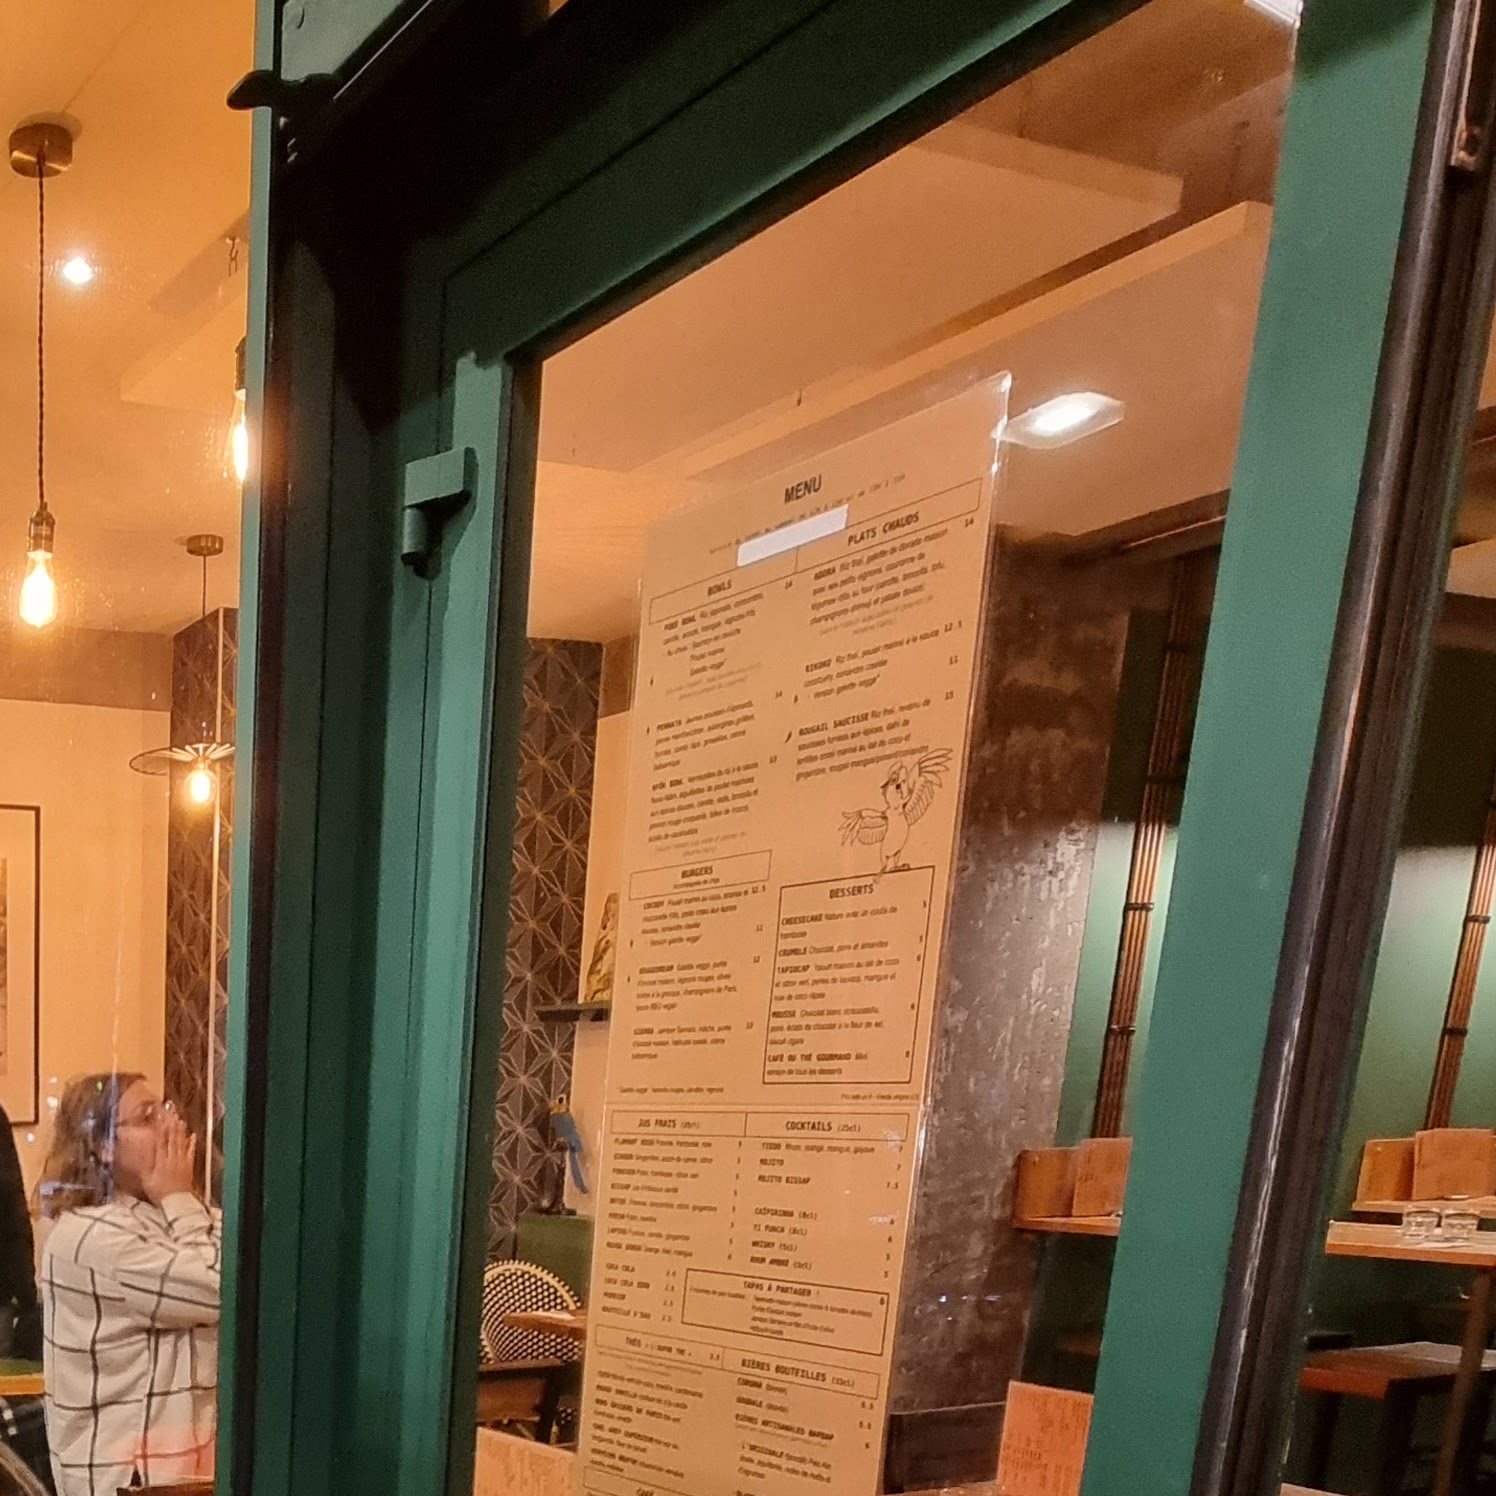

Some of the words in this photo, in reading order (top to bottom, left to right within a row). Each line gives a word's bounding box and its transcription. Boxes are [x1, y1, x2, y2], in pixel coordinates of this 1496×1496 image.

[783, 472, 823, 505] MENU
[847, 526, 876, 547] PLATS
[882, 510, 920, 534] CHAUDS
[964, 516, 974, 527] 14
[707, 578, 731, 596] BOWLS
[798, 721, 828, 736] ROUGAIL
[833, 711, 869, 728] SAUCISSE
[680, 864, 713, 878] BURGERS
[828, 883, 874, 899] DESSERTS
[781, 913, 822, 925] CHEESECAKE
[767, 1053, 784, 1062] CAFÉ
[787, 1053, 796, 1061] OU
[637, 1118, 651, 1127] JUS
[654, 1119, 676, 1128] FRAIS
[784, 1120, 832, 1131] COCKTAILS
[759, 1158, 784, 1166] MOJITO
[757, 1174, 782, 1183] MOJITO
[743, 1280, 763, 1290] TAPAS
[775, 1284, 812, 1297] PARTAGER
[741, 1357, 771, 1372] BIÈRES
[774, 1363, 826, 1383] BOUTEILLES
